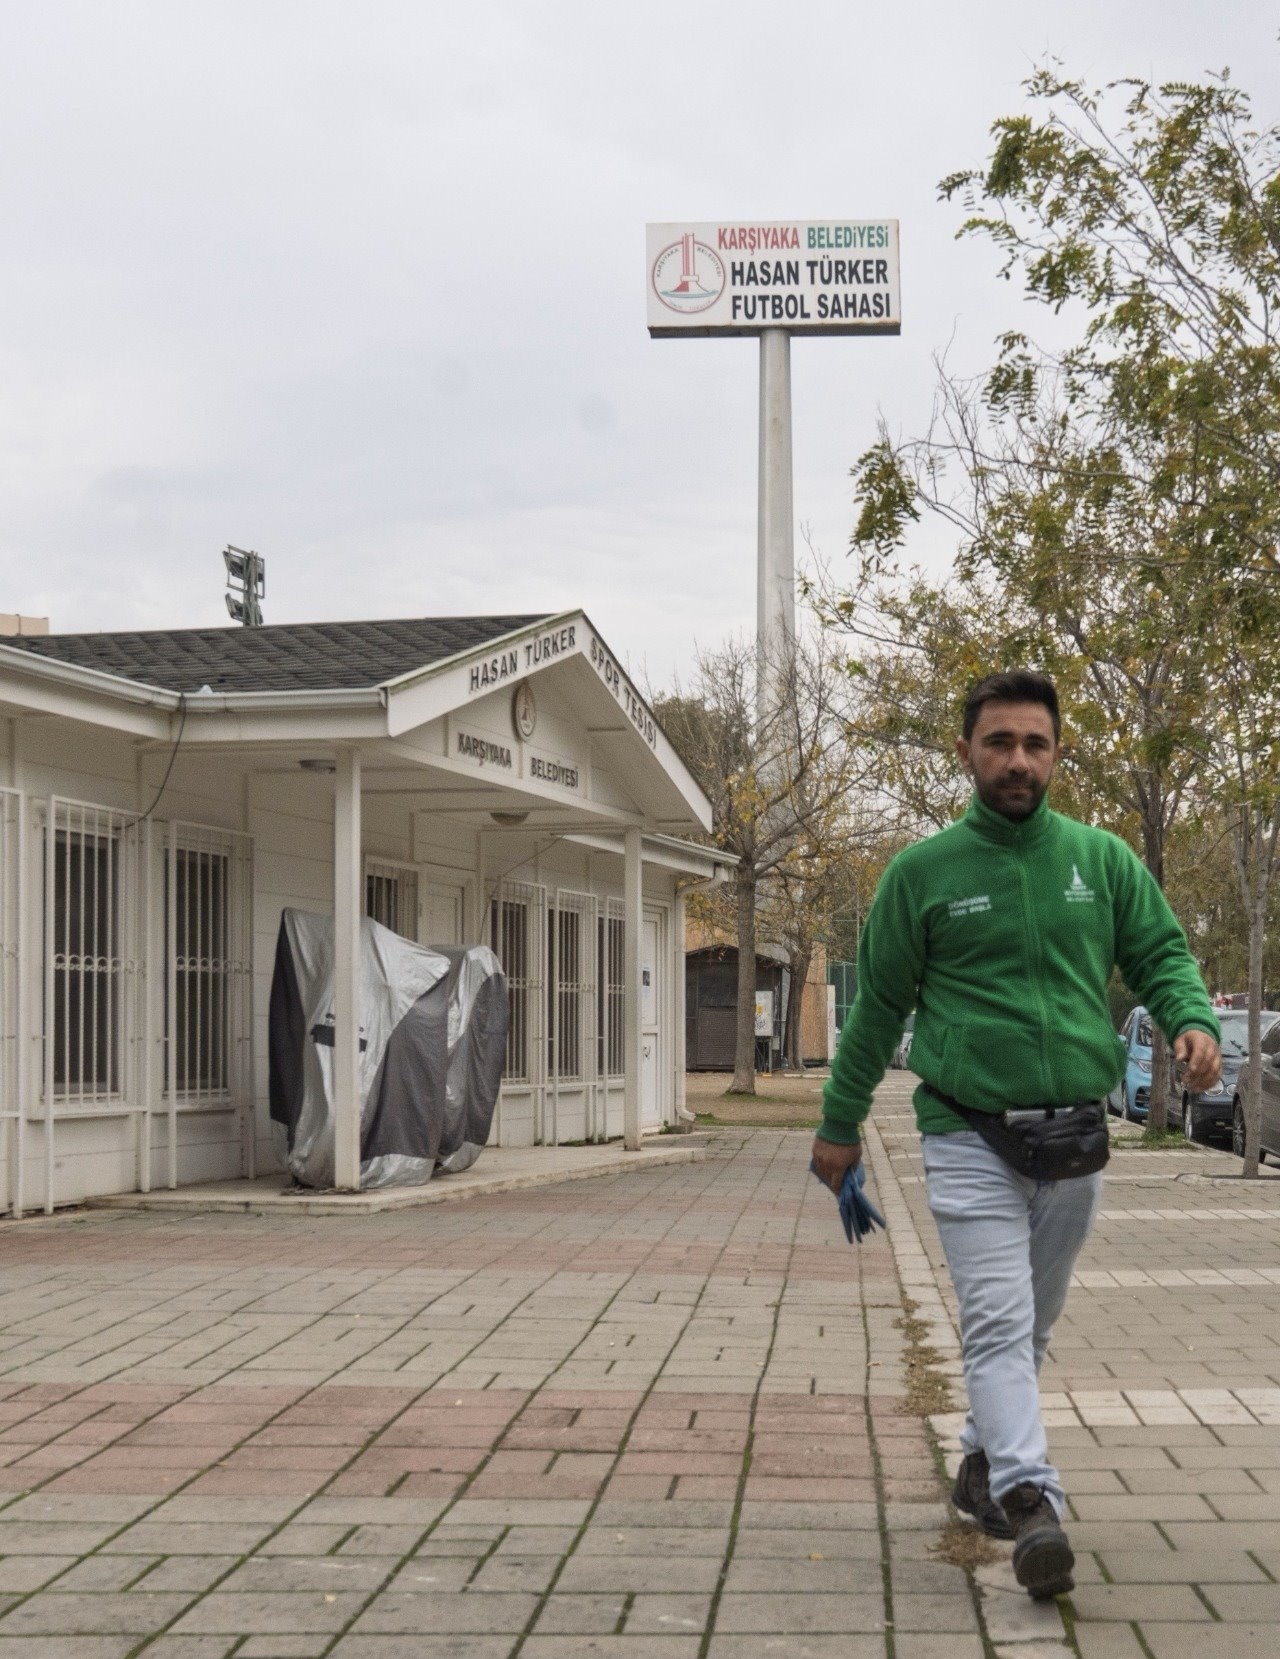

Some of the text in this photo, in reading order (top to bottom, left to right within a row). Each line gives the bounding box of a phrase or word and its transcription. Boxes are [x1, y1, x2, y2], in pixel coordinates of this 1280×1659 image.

[718, 226, 889, 255] KARŞIYAKA BELEDİYESİ
[731, 255, 889, 286] HASAN TÜRKER
[731, 294, 811, 320] FUTBOL
[817, 292, 891, 319] SAHASI
[469, 625, 576, 693] HASAN TÜRKER
[591, 636, 620, 698] SPOR
[457, 733, 579, 788] KARŞIYAKA BELEDİYESİ
